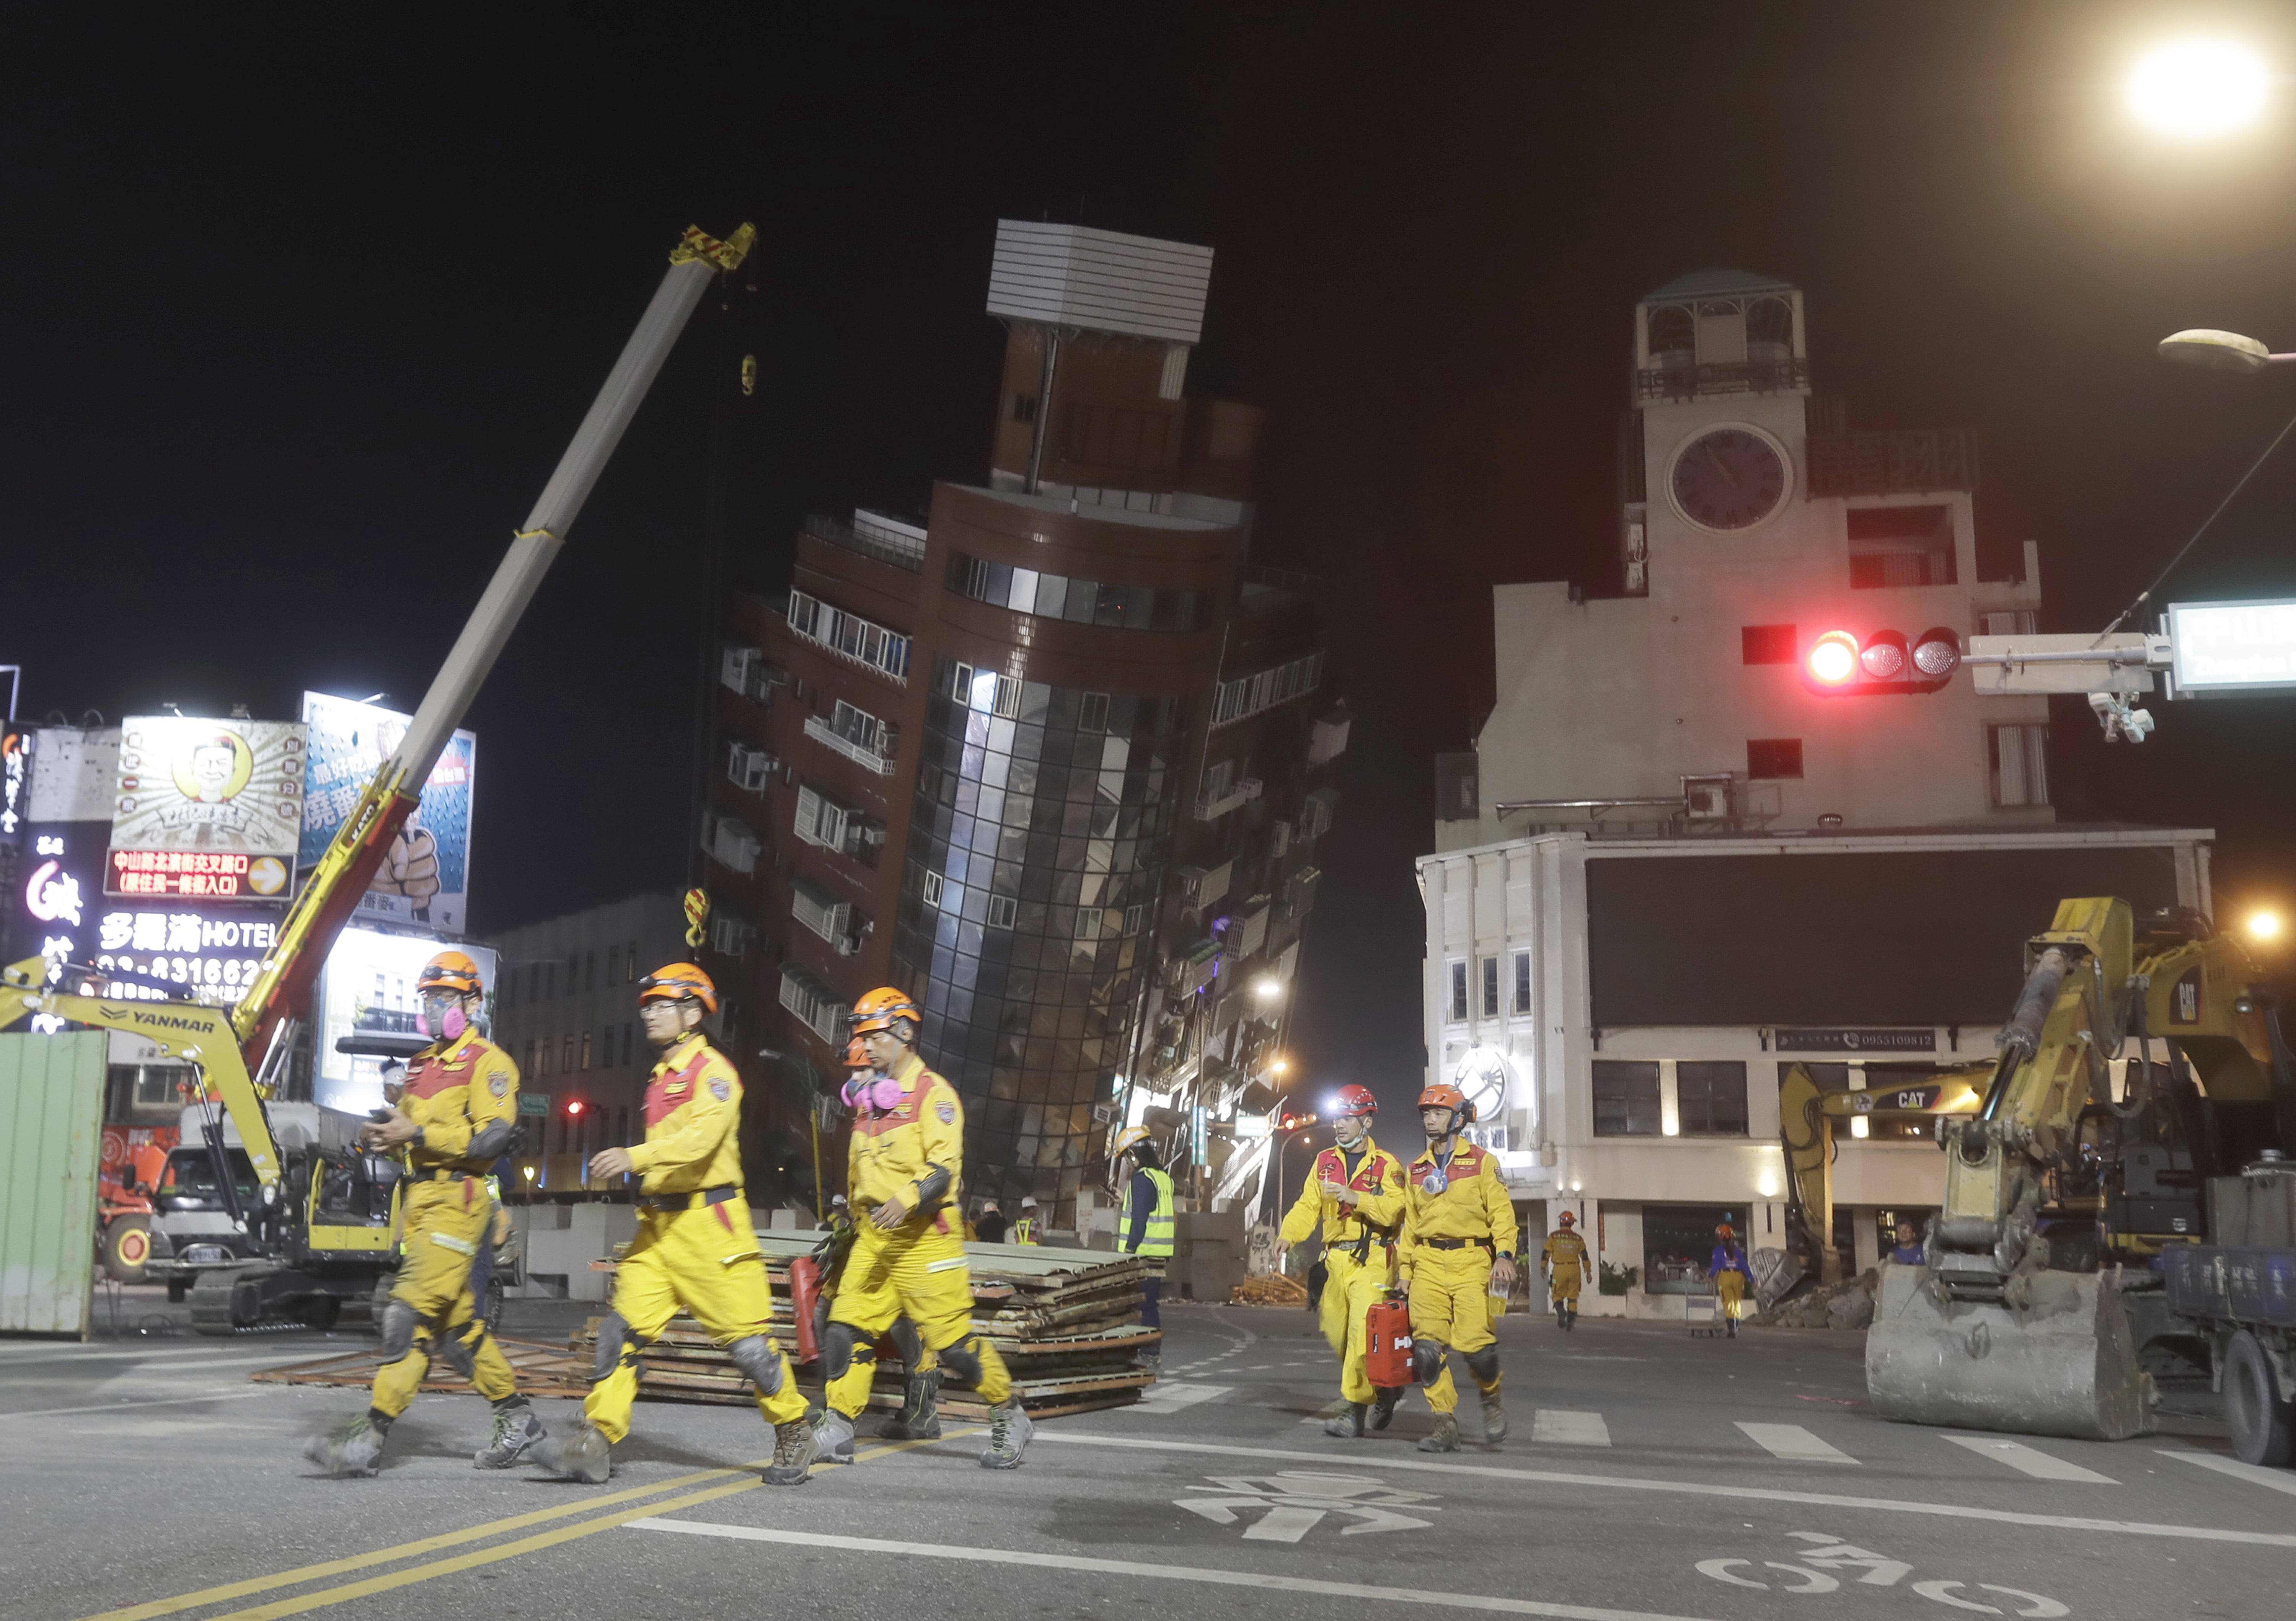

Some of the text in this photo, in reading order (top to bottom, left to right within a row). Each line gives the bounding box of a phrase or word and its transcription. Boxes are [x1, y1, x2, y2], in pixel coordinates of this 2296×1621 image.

[202, 921, 277, 947] HOTEL
[2180, 983, 2197, 1021] CAT
[133, 1011, 214, 1033] YANMAR
[1898, 1092, 1925, 1108] CAT
